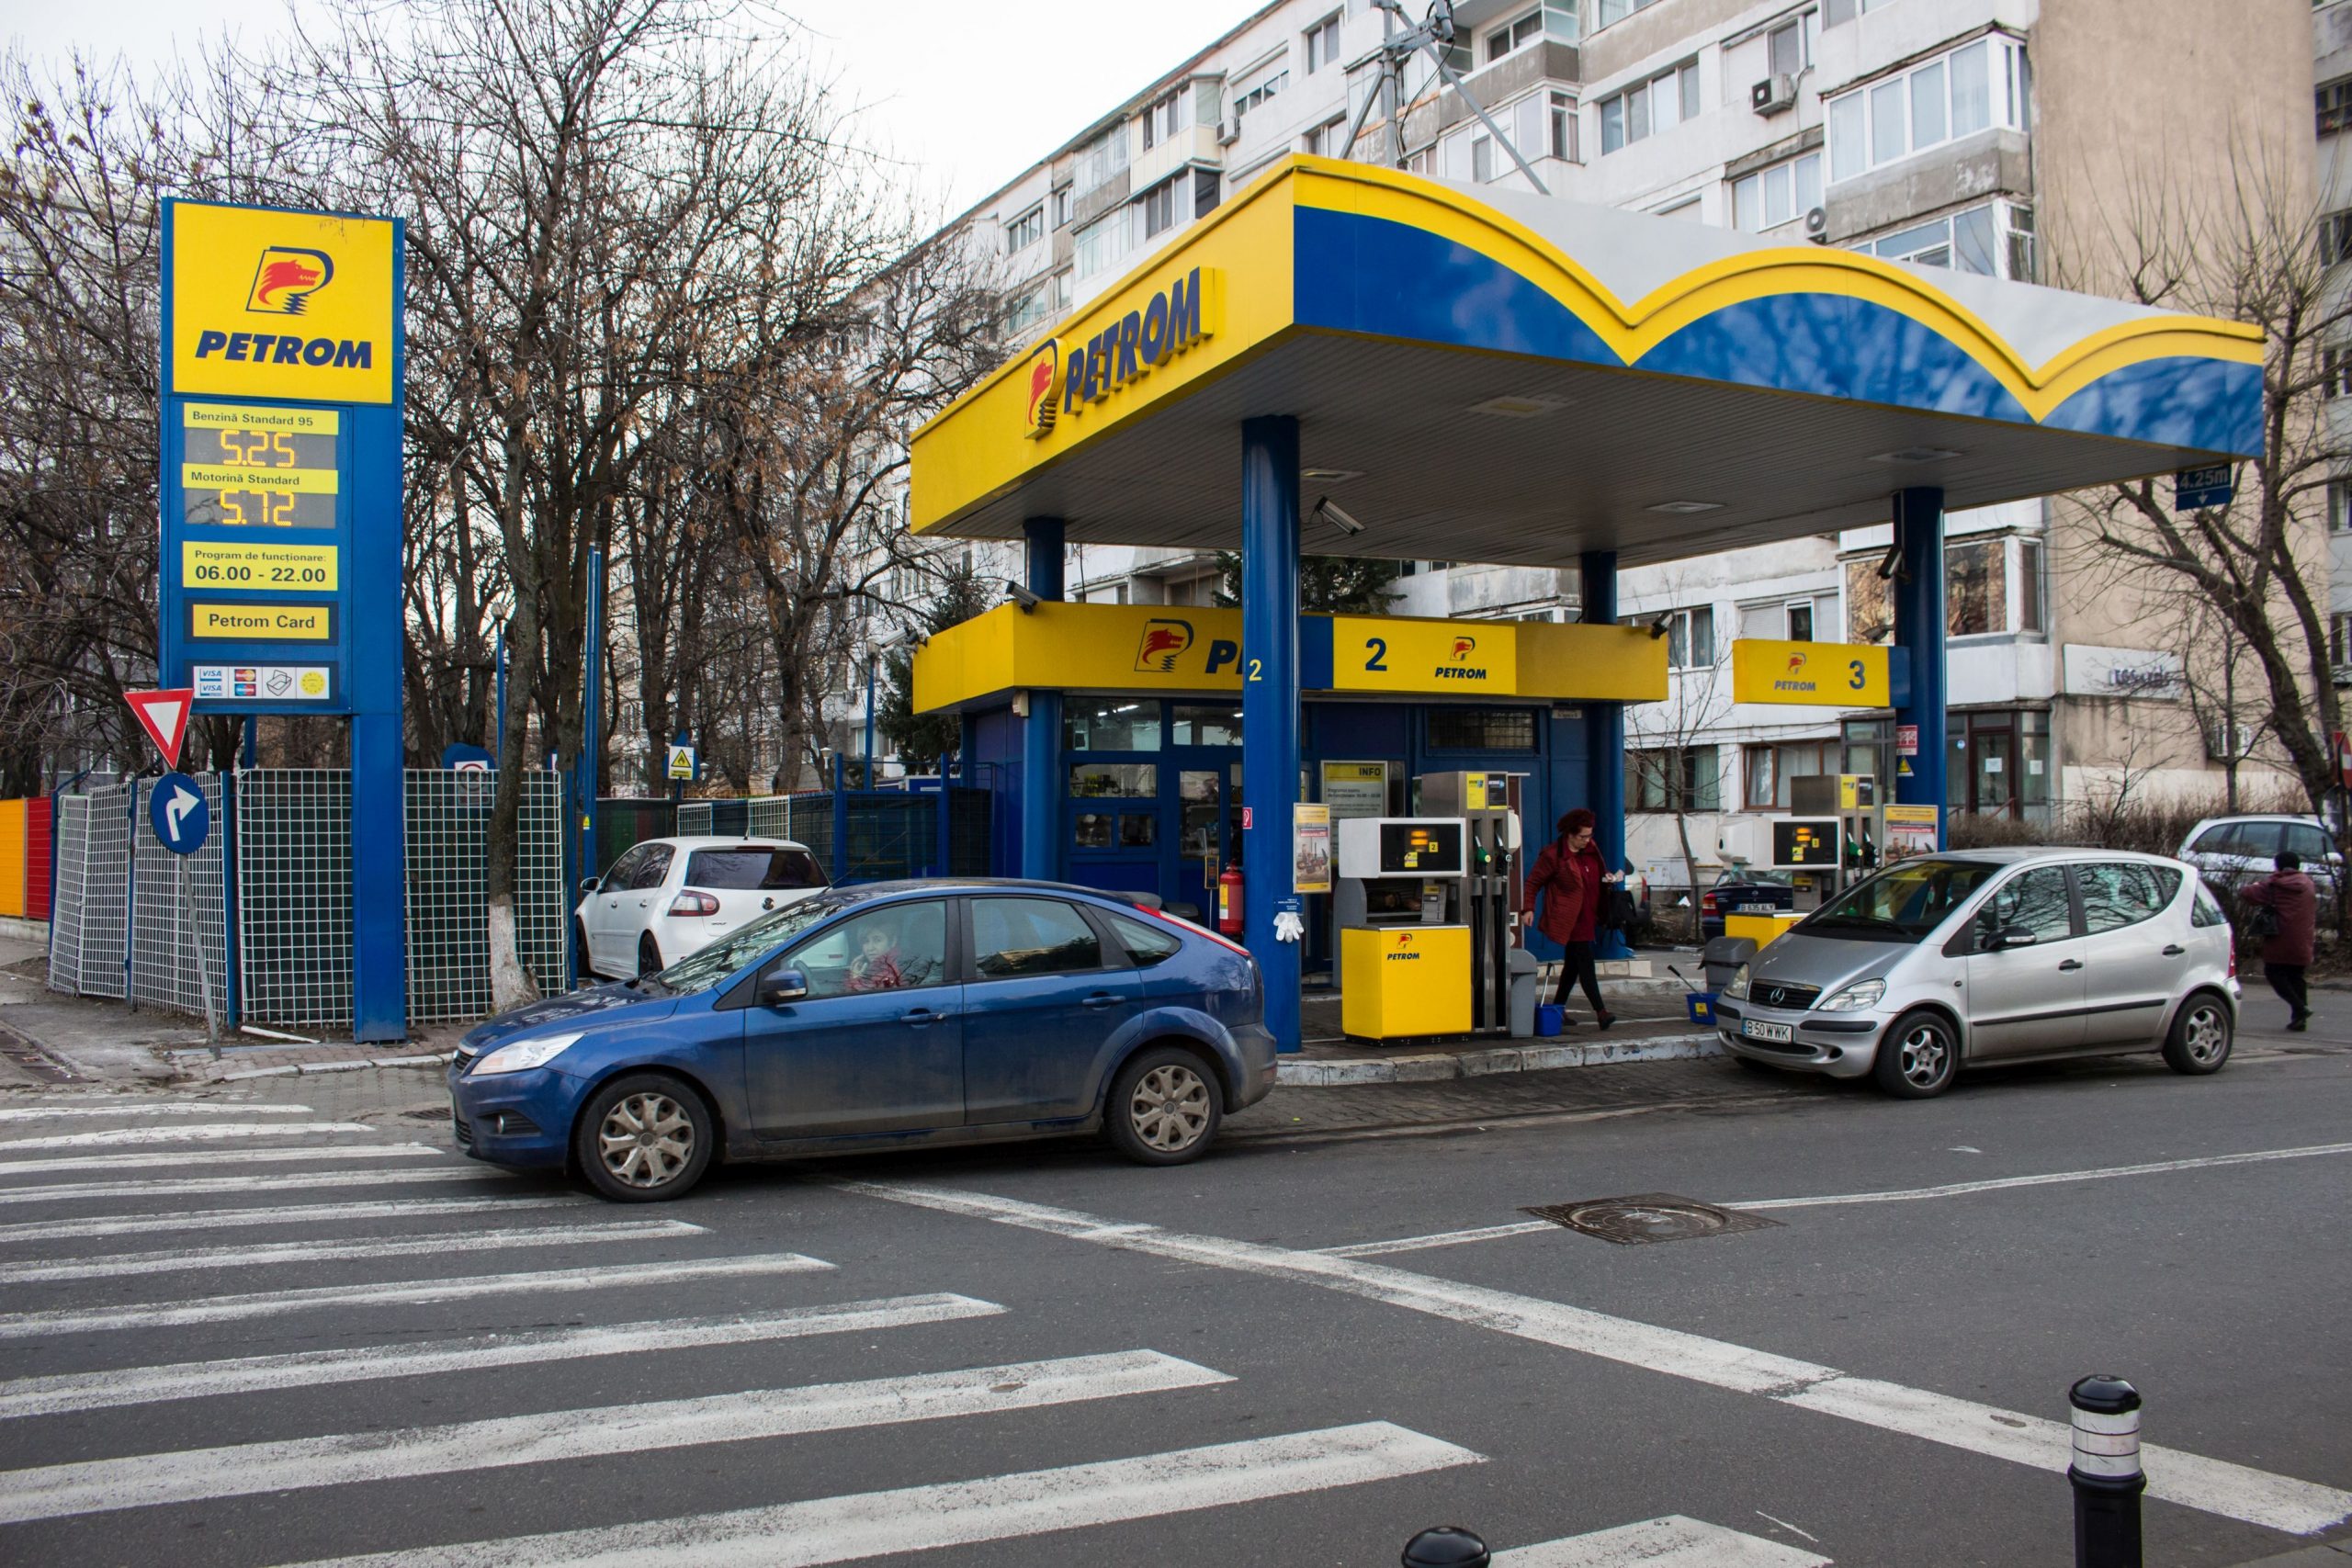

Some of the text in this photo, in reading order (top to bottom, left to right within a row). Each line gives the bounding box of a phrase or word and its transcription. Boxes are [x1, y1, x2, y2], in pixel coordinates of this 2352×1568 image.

[1064, 265, 1200, 414] PETROM
[195, 330, 372, 369] PETROM
[192, 411, 313, 426] Benzină Standard 95
[220, 429, 295, 468] 5.25
[191, 471, 300, 486] Motorină Standard
[2180, 468, 2228, 489] 4.25m
[195, 550, 242, 561] Program
[244, 552, 258, 560] de
[195, 565, 252, 581] 06.00
[271, 568, 326, 582] 22.00
[209, 614, 315, 628] Petrom Card
[1365, 637, 1387, 671] 2
[1249, 659, 1262, 682] 2
[1435, 667, 1487, 680] PETROM
[1849, 660, 1866, 690] 3
[1774, 681, 1816, 691] PETROM
[1359, 767, 1381, 776] INFO
[1747, 1021, 1789, 1040] B 50 WWK
